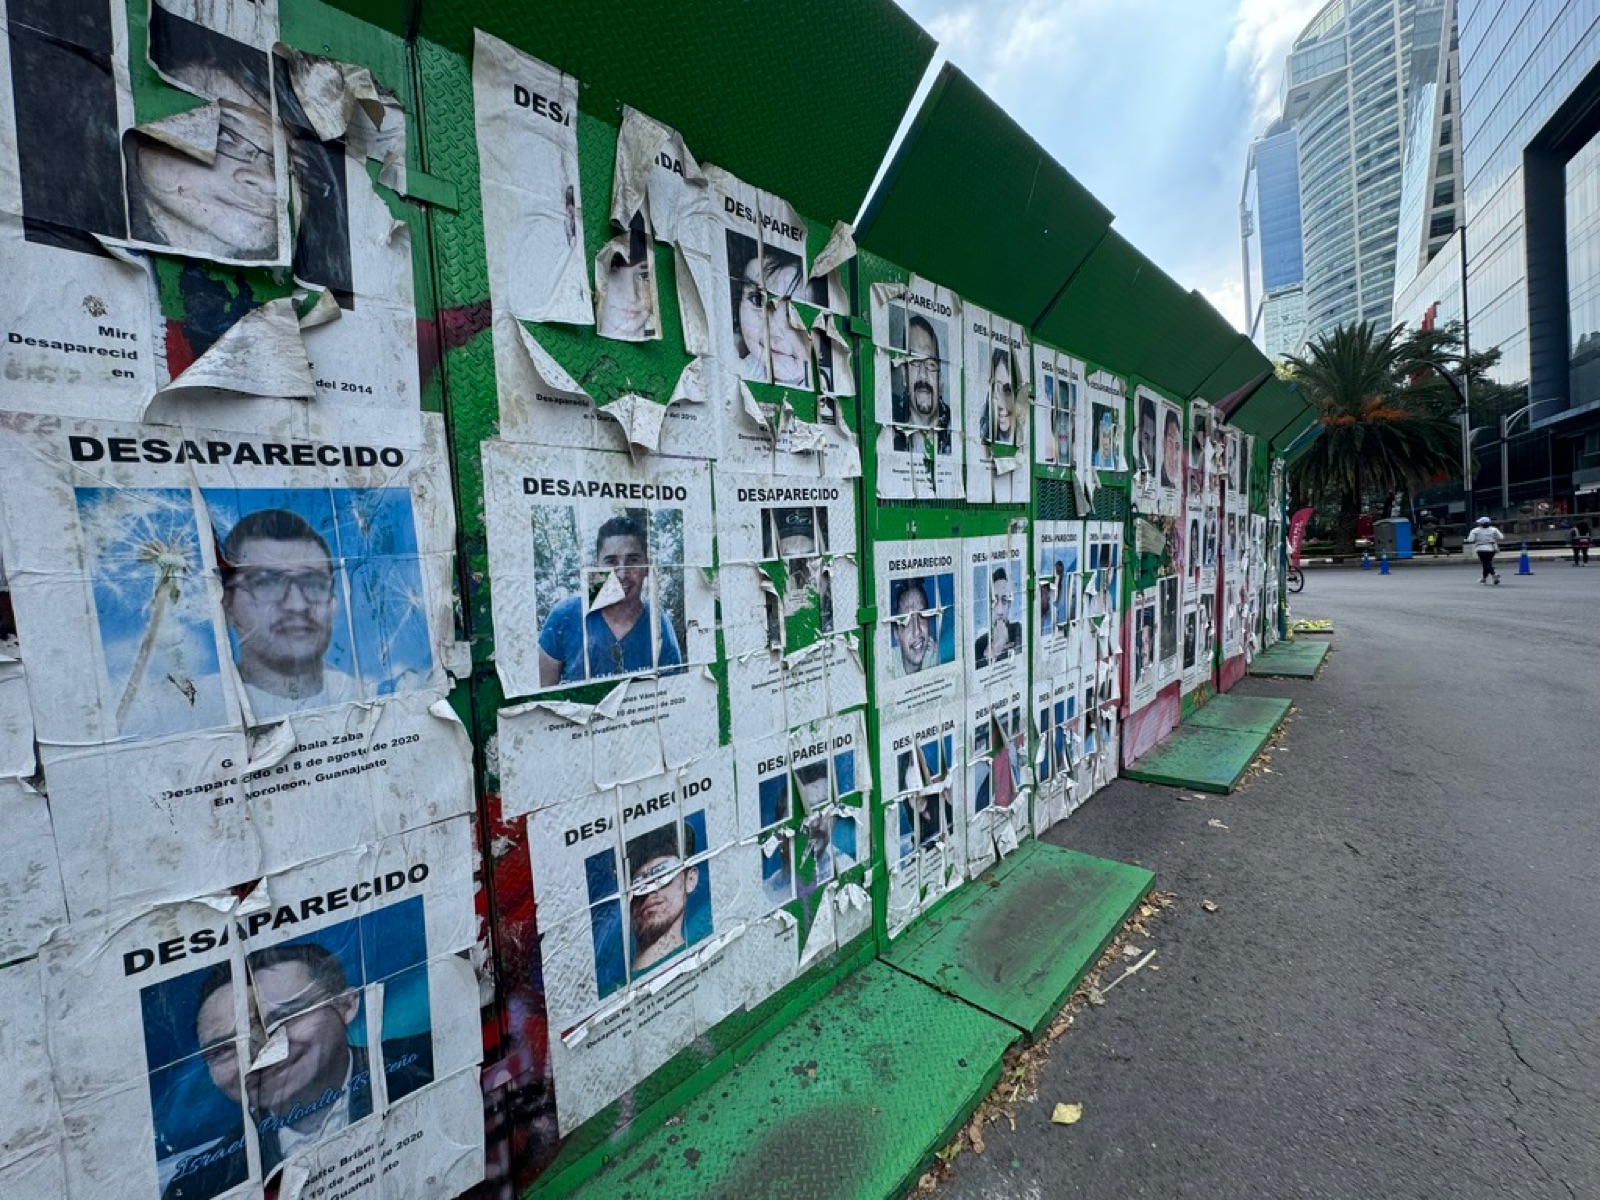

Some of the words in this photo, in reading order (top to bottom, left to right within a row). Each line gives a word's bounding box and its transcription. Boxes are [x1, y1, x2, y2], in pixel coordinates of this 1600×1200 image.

[111, 366, 135, 379] en
[315, 378, 337, 390] del
[340, 382, 373, 395] 2014
[68, 434, 405, 469] DESAPARECIDO
[522, 476, 688, 501] DESAPARECIDO
[737, 487, 840, 502] DESAPARECIDO
[888, 555, 953, 571] DESAPARECIDO
[332, 731, 364, 745] Zaba
[276, 763, 290, 775] el
[293, 761, 303, 771] 8
[306, 756, 324, 768] de
[372, 740, 389, 752] de
[390, 732, 421, 748] 2020
[213, 795, 235, 808] En
[315, 757, 388, 784] Guanajuato
[122, 862, 430, 978] DESAPARECIDO
